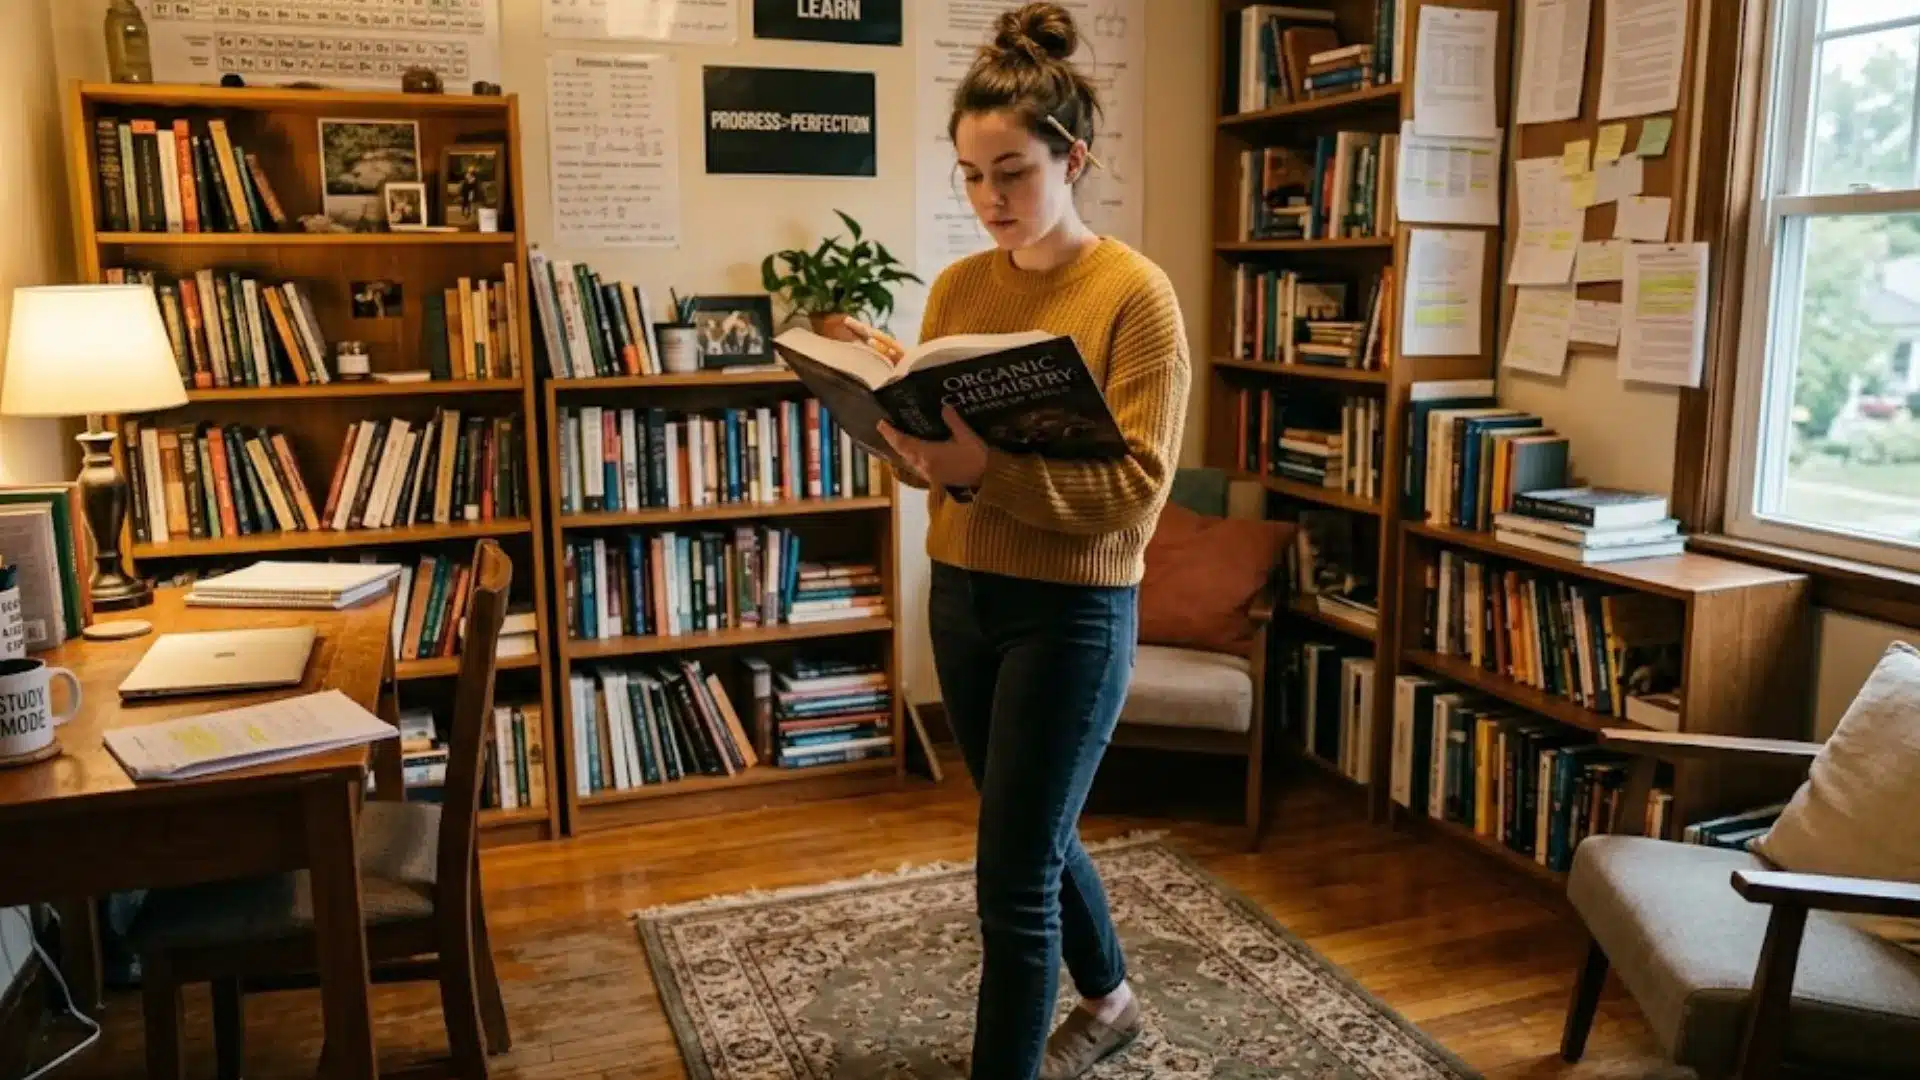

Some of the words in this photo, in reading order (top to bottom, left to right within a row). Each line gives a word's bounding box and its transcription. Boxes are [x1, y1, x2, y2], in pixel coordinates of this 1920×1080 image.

[797, 0, 861, 20] LEARN
[941, 367, 1073, 405] CHEMISTRY
[943, 354, 1056, 391] ORGANIC
[0, 686, 44, 715] STUDY
[0, 709, 46, 737] MODE
